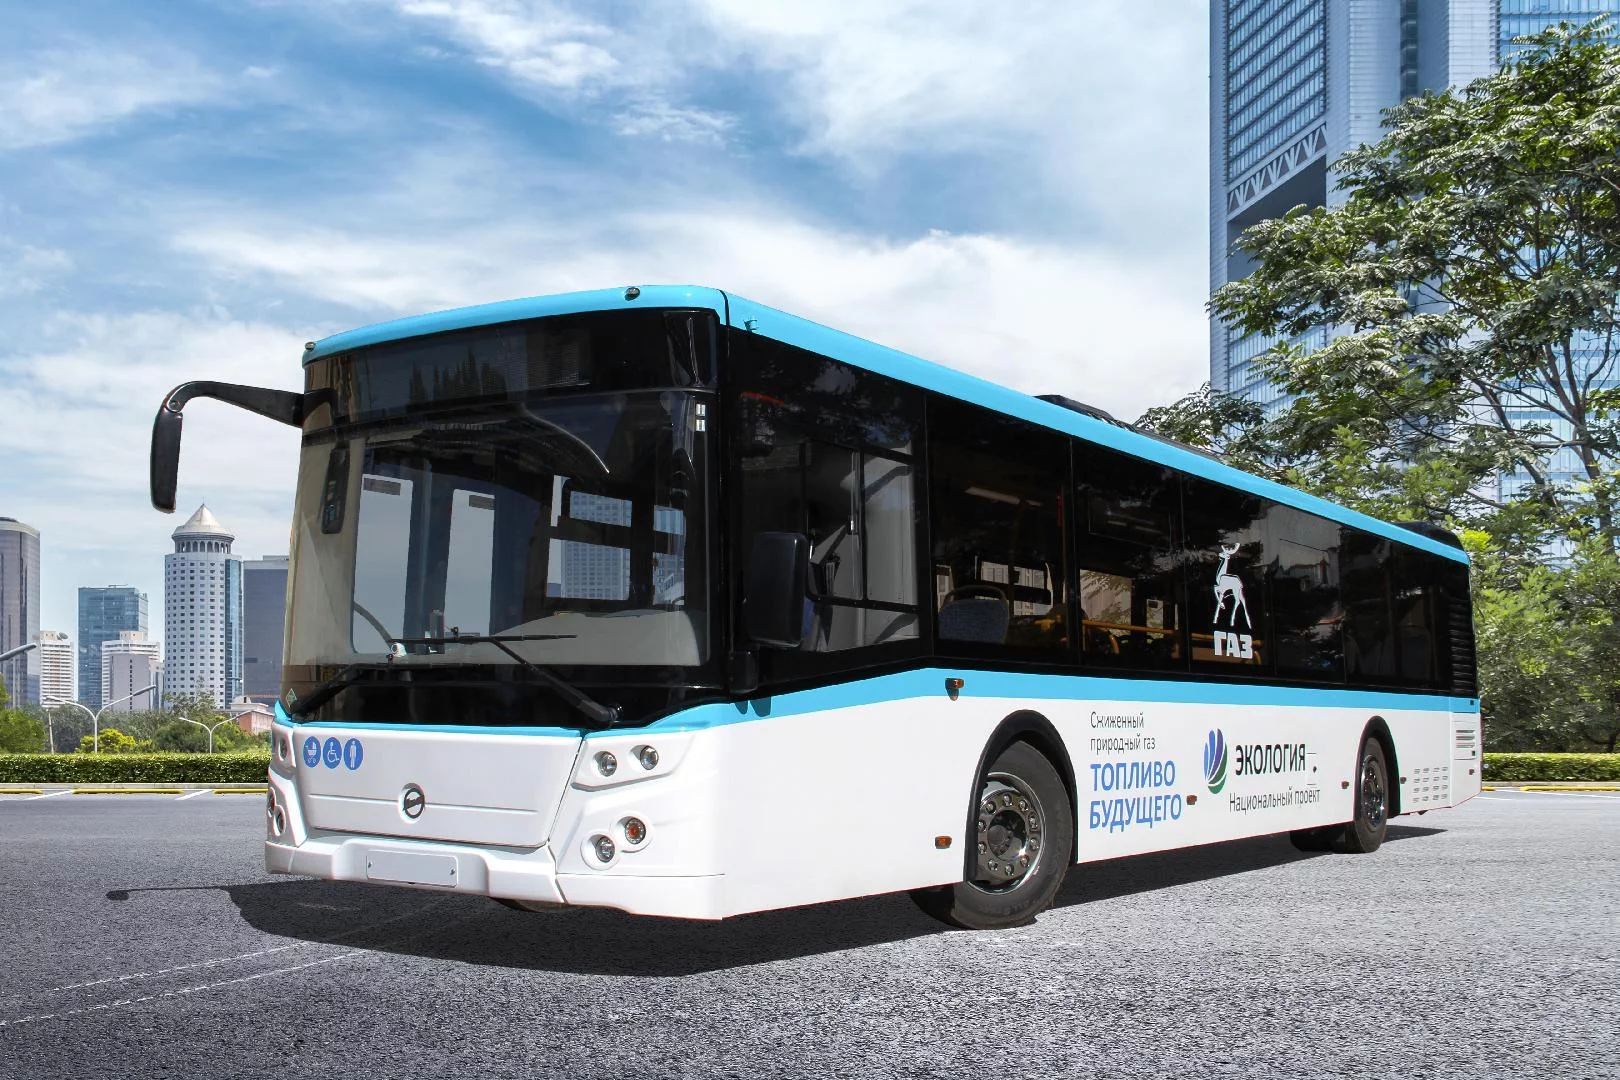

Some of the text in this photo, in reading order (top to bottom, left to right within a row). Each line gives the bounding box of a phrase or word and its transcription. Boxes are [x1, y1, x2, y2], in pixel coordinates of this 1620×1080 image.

[1213, 630, 1253, 659] ГАЗ
[1090, 711, 1144, 728] Сжиженный
[1090, 732, 1156, 755] природный газ
[1235, 743, 1306, 776] ЭКОЛОГИЯ
[1090, 760, 1175, 791] ТОПЛИВО
[1089, 794, 1182, 834] БУДУЩЕГО
[1229, 785, 1320, 815] Национальный проект
